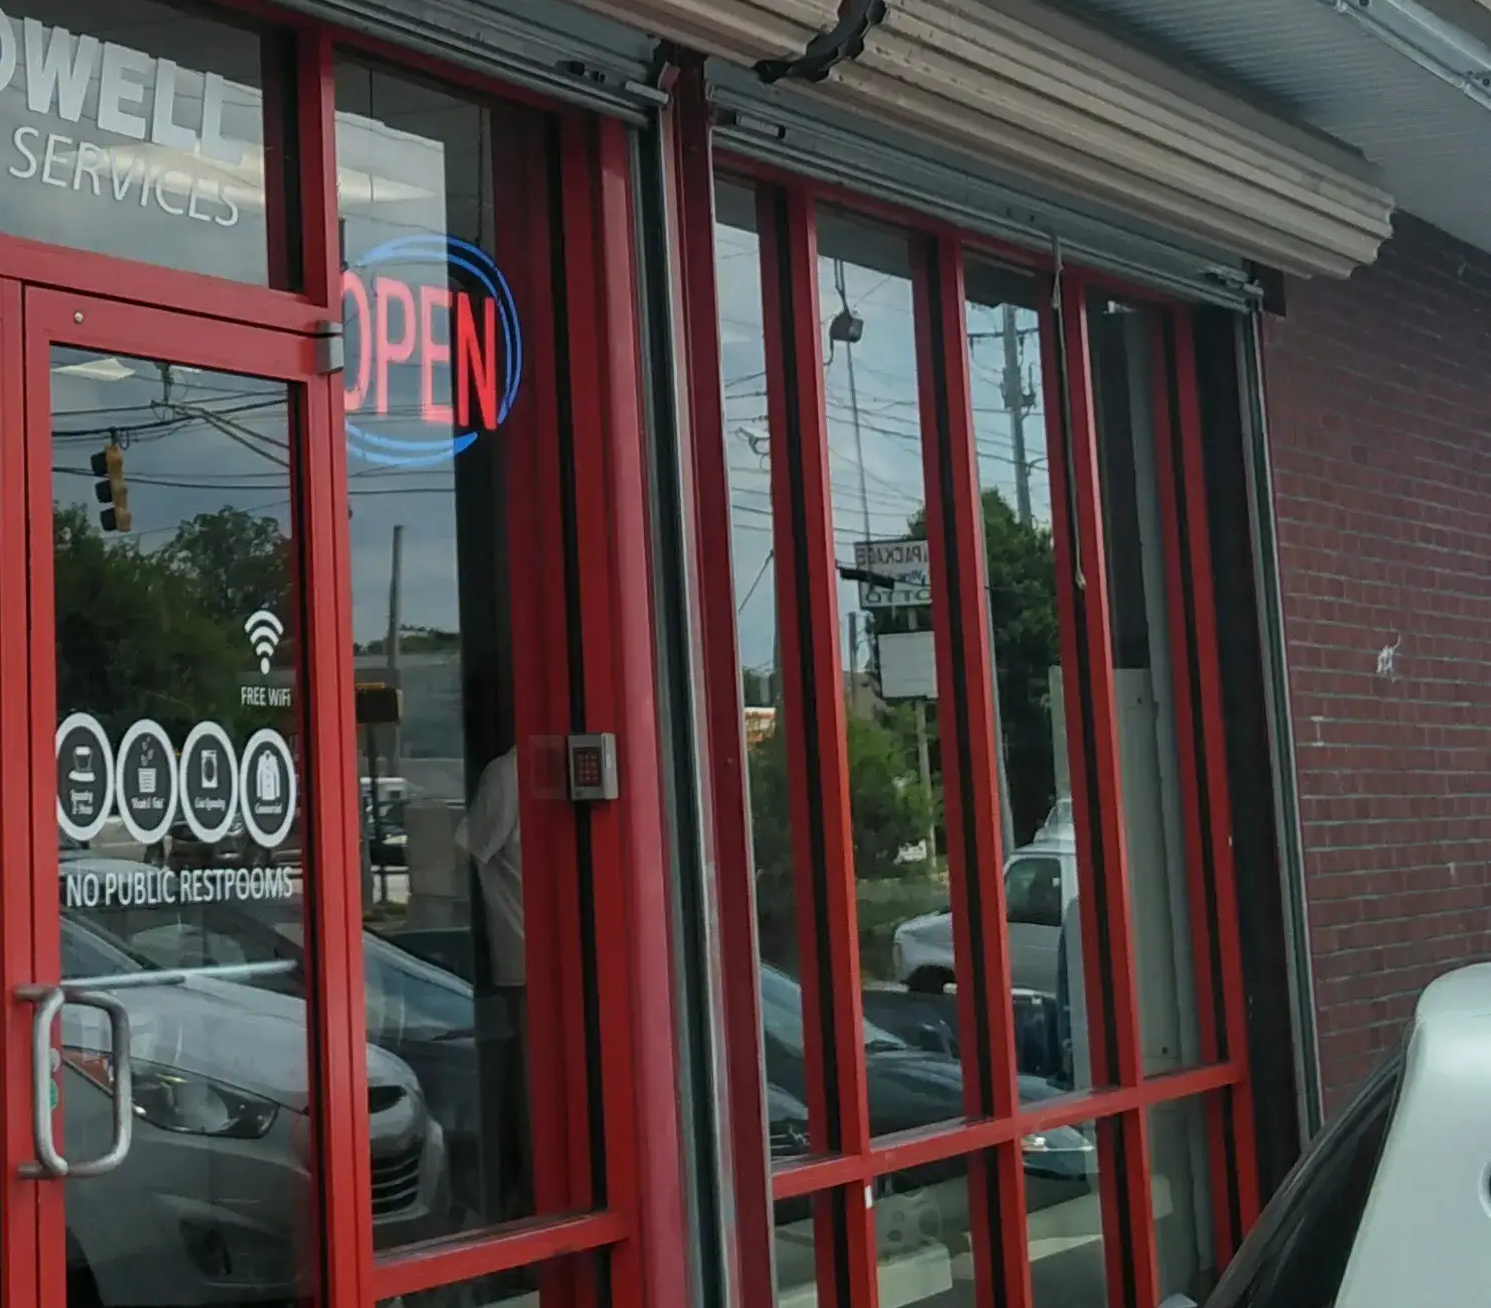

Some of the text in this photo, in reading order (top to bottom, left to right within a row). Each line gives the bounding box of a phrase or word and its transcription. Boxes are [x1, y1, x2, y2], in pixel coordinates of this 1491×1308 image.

[10, 126, 239, 227] SERVICES
[341, 269, 497, 431] OPEN
[240, 686, 267, 706] FREE
[66, 872, 99, 907] NO
[105, 869, 176, 906] PUBLIC
